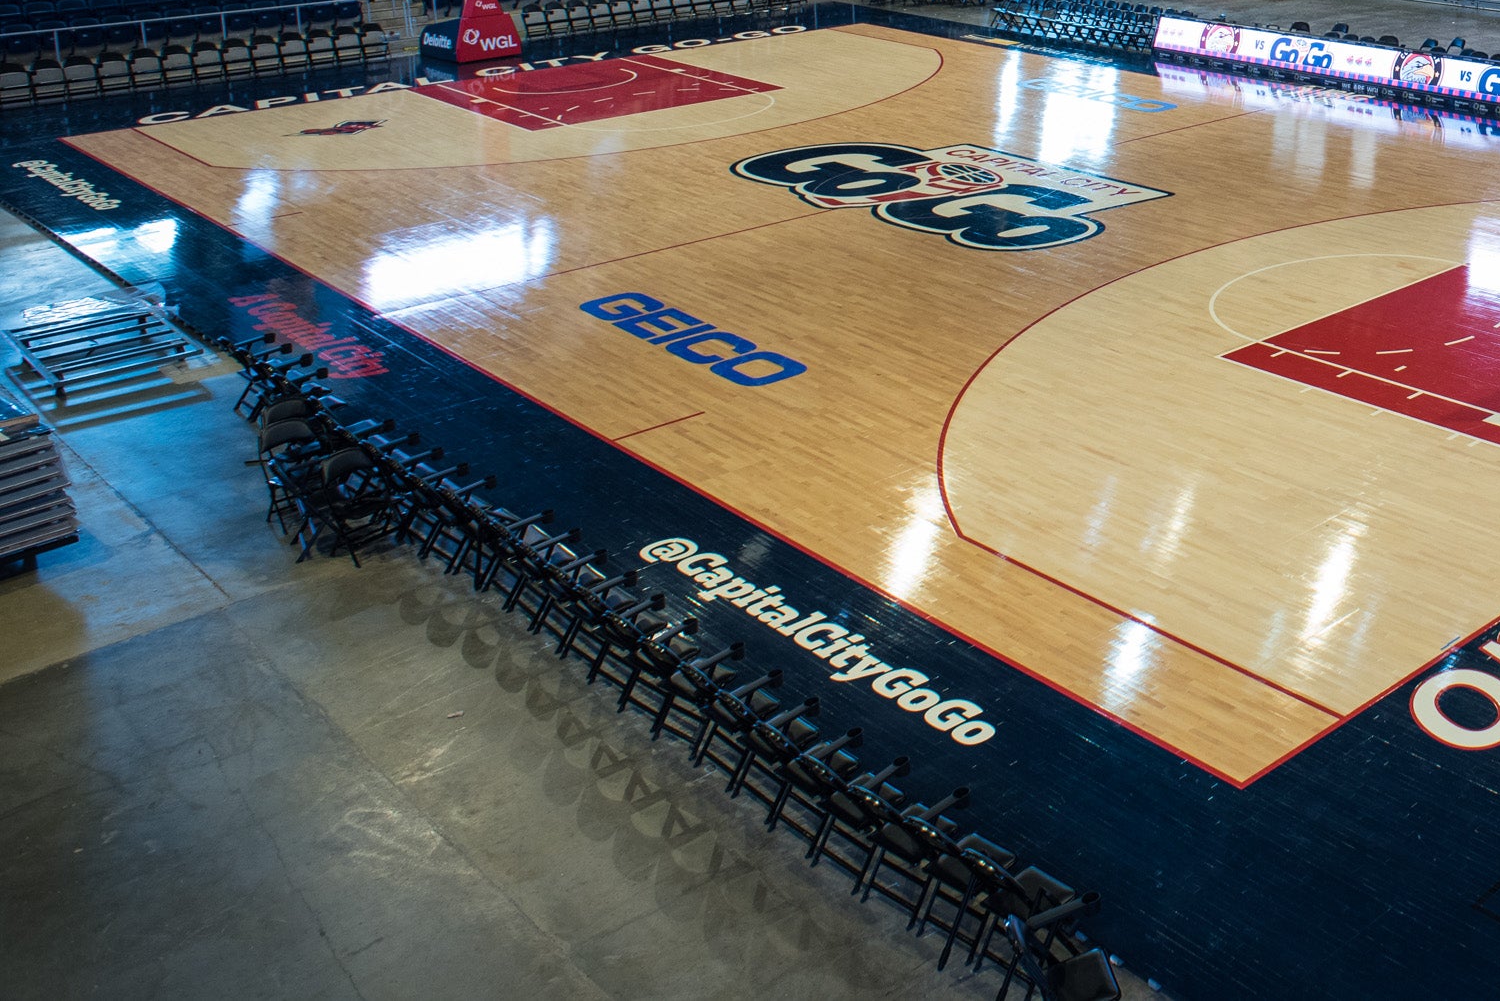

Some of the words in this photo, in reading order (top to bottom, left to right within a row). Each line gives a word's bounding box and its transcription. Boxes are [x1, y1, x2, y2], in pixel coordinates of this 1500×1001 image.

[480, 34, 518, 52] WGL
[1254, 39, 1265, 50] VS
[137, 77, 455, 126] CAPITAL
[474, 51, 609, 78] CITY
[631, 24, 807, 55] GO-GO
[1459, 69, 1472, 82] VS
[1060, 177, 1142, 197] CITY
[247, 301, 356, 350] Capital
[317, 343, 390, 380] City
[579, 291, 808, 387] GEICO
[638, 536, 997, 747] @CapitalCityGoGo
